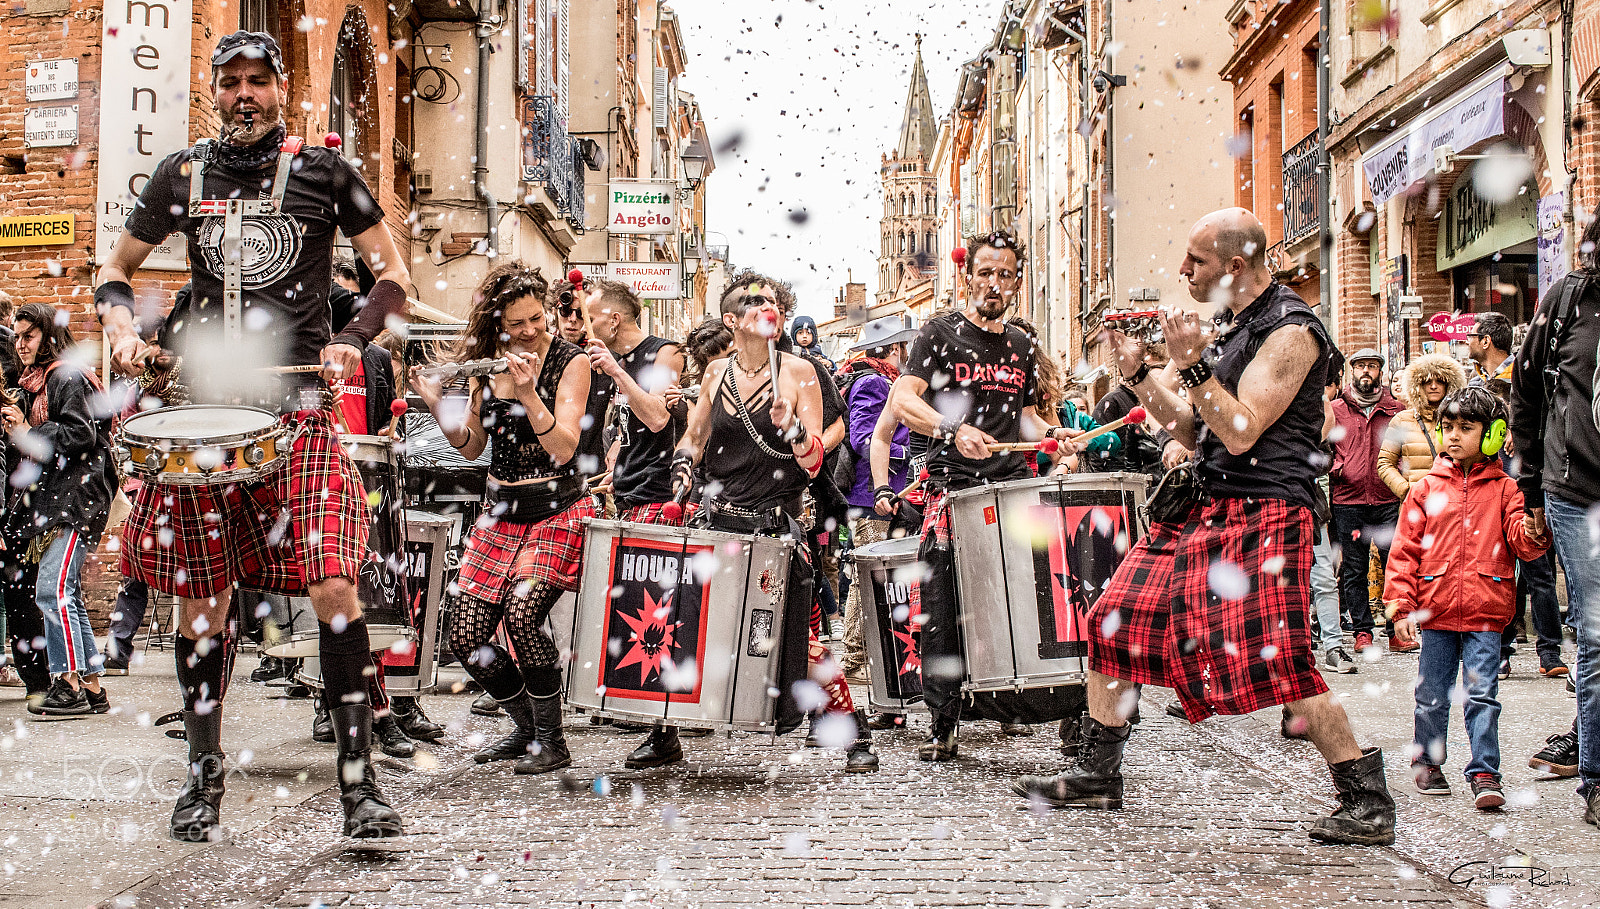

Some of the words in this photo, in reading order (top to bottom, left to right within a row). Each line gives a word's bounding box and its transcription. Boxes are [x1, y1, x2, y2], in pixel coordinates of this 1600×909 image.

[44, 61, 59, 71] RUE
[26, 83, 57, 95] PENITENTS
[63, 81, 78, 92] GRIS
[34, 108, 68, 119] CARRIERA
[25, 130, 55, 141] PENITENTS
[57, 129, 77, 140] GRISES
[613, 212, 671, 228] Angelo
[0, 220, 70, 238] MMERCES
[615, 267, 672, 276] RESTAURANT
[621, 553, 694, 585] HOUBA
